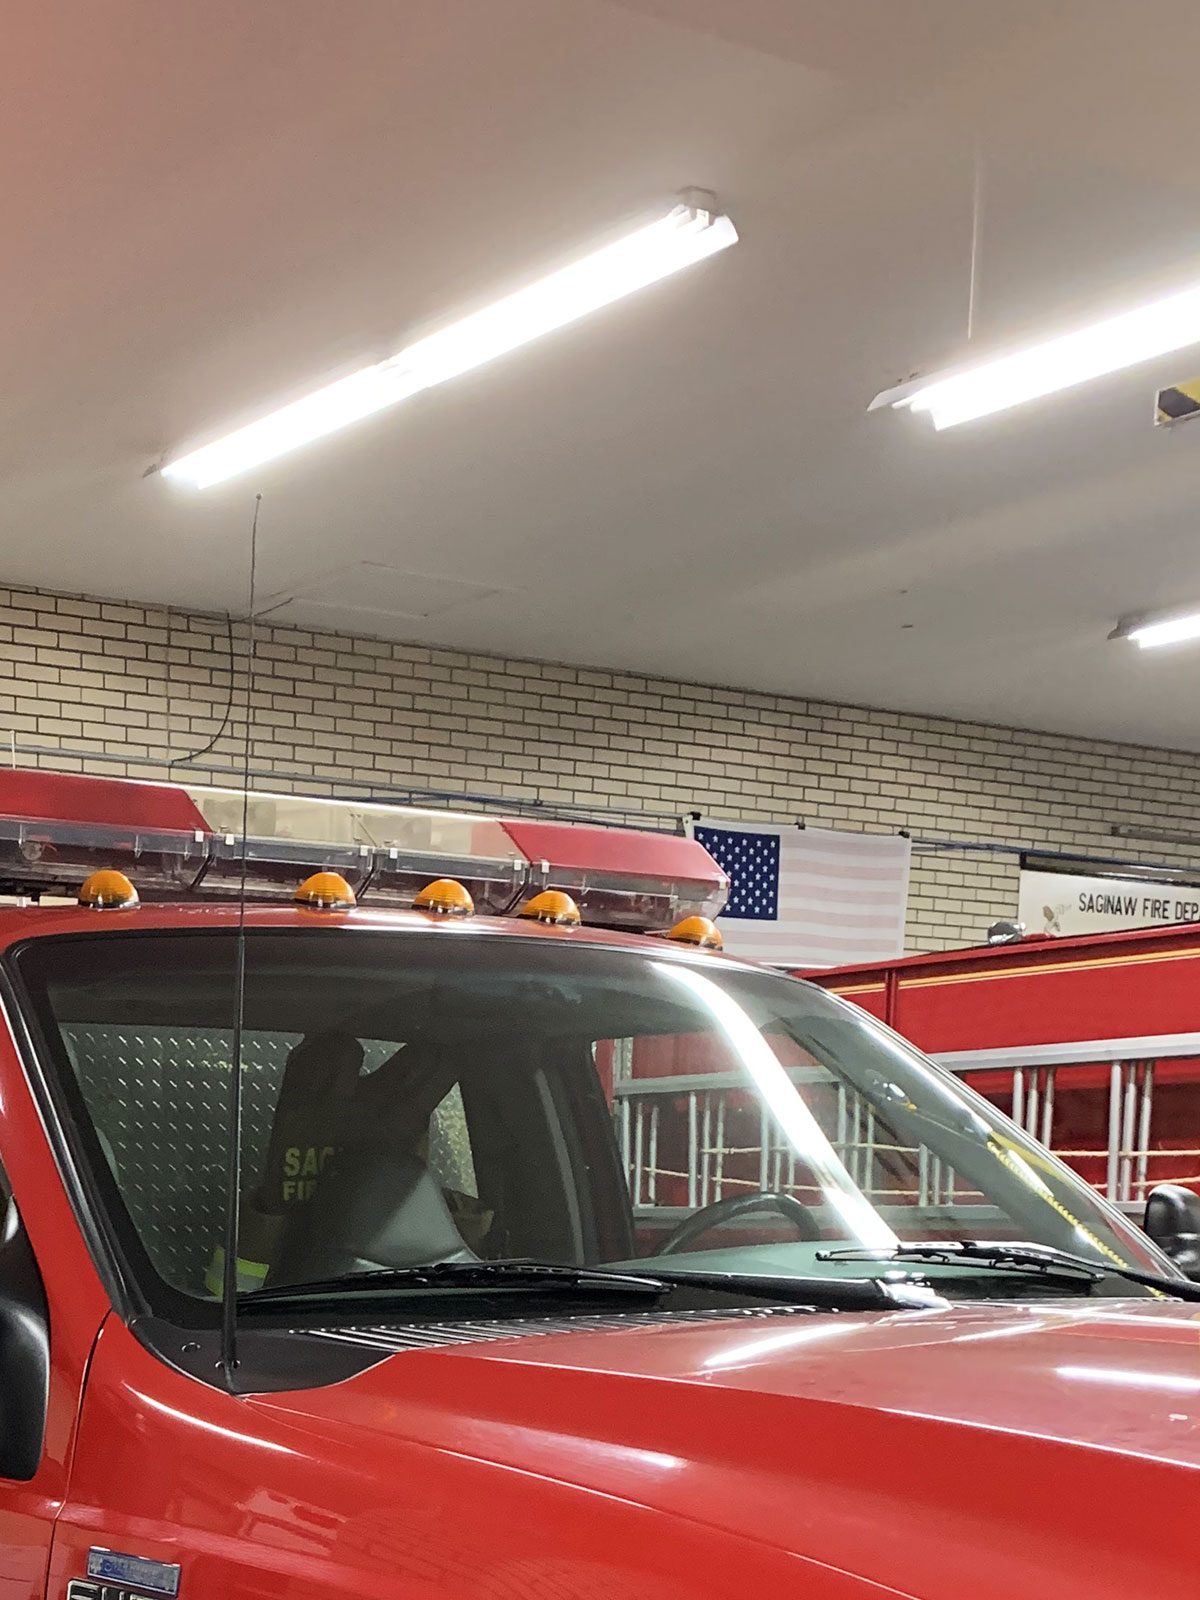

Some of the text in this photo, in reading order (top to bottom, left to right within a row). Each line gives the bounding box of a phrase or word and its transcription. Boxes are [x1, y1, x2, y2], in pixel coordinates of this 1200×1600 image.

[1078, 892, 1200, 921] SAGINAW FIRE DEP
